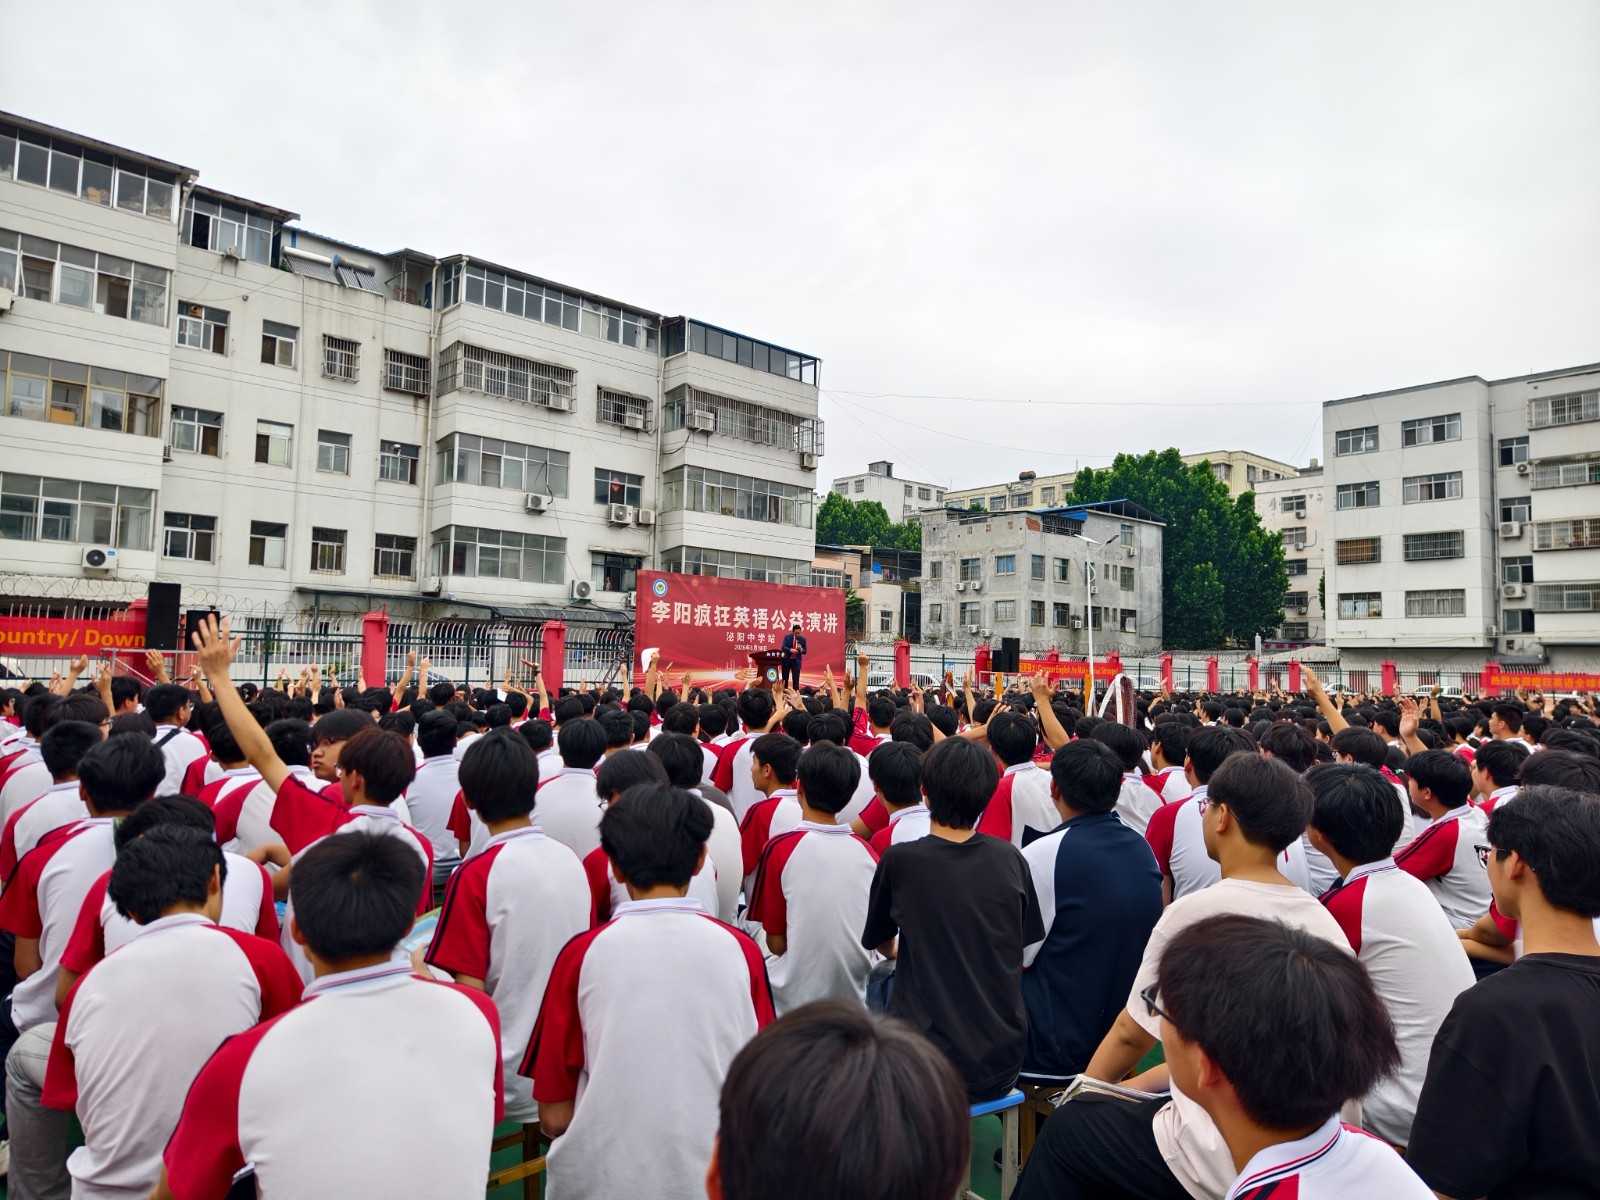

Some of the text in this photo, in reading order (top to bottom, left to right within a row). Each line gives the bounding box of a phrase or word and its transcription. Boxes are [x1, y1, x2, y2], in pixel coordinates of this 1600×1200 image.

[651, 600, 838, 634] 李阳疯狂英语公益演讲
[726, 631, 776, 644] 泌阳中学站
